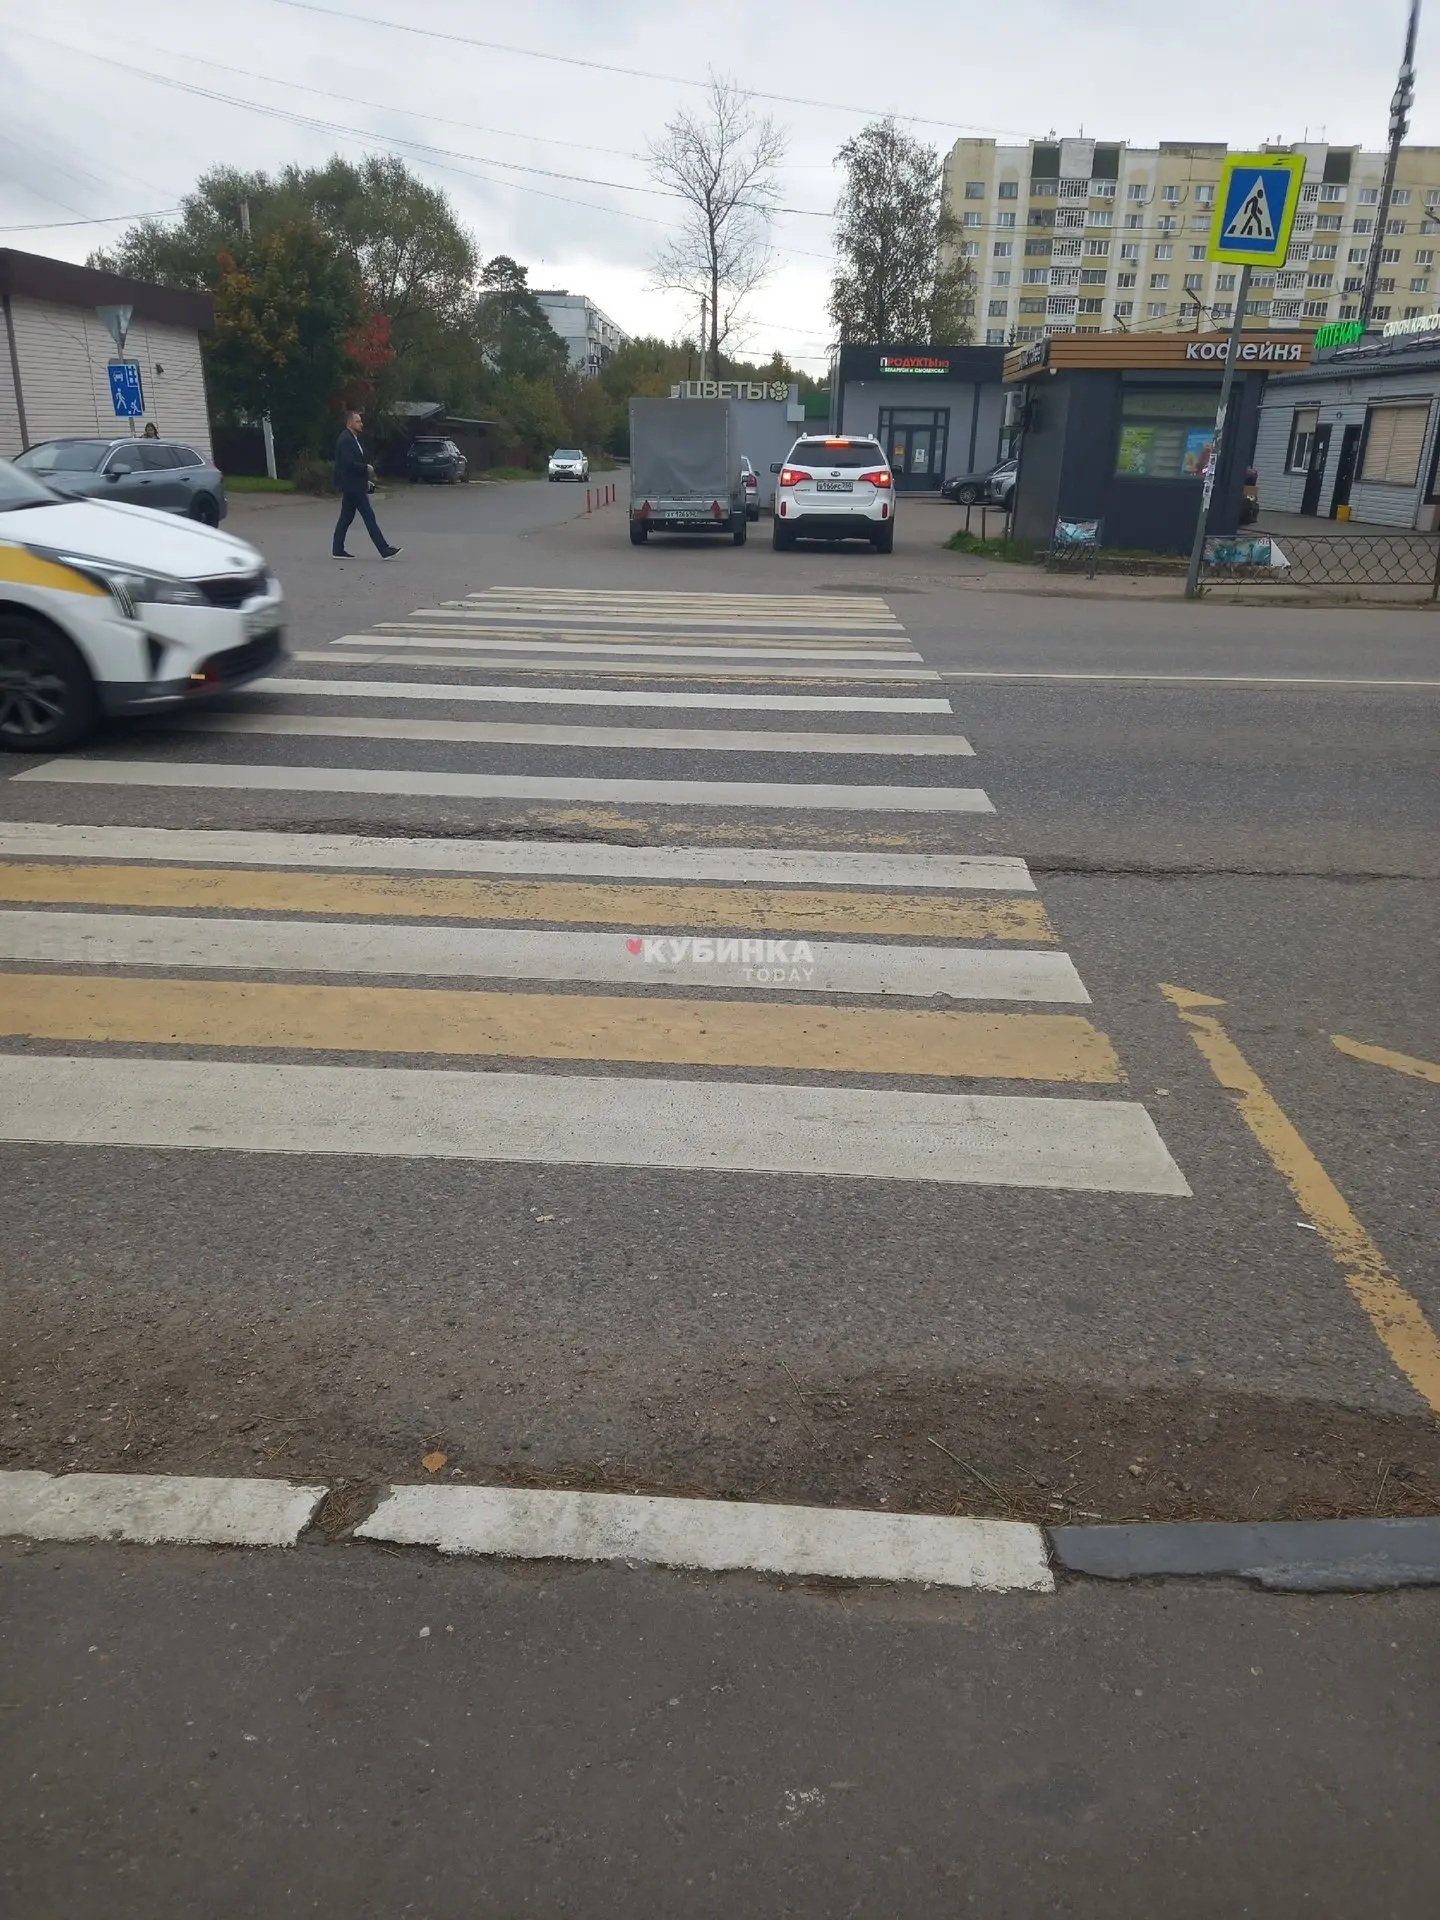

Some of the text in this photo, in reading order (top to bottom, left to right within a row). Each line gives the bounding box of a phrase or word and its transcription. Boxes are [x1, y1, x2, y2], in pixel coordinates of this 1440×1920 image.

[1411, 313, 1440, 333] КРАСО
[1314, 320, 1354, 349] АПТЕКА
[880, 357, 938, 367] ПРОДУКТЫ
[686, 380, 767, 399] ЦВЕТЫ
